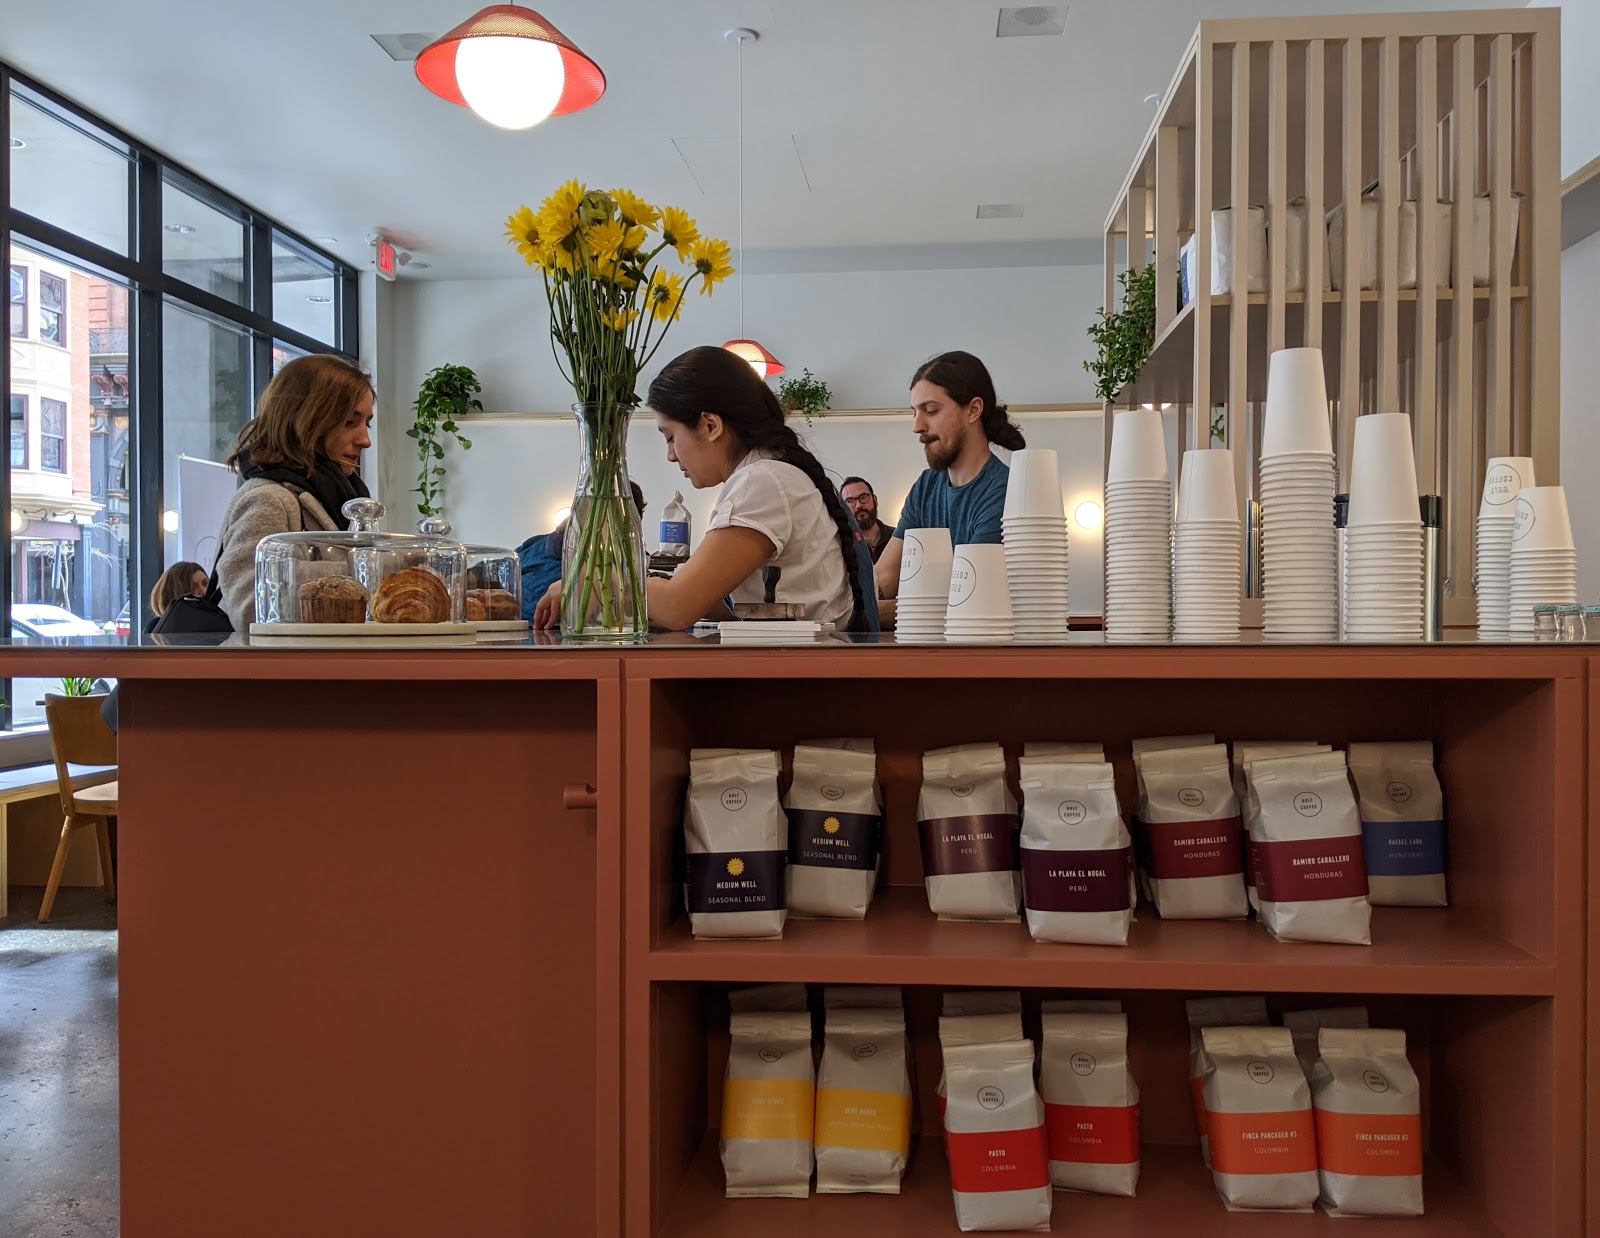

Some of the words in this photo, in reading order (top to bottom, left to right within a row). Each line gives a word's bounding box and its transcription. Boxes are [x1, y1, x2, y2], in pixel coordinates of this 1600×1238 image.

[1488, 475, 1513, 484] COFFEE
[812, 837, 834, 846] MEDIUM
[835, 839, 850, 847] WELL
[1196, 836, 1227, 845] CABALLERO
[802, 851, 835, 859] SEASONAL
[837, 853, 857, 861] BLEND
[1184, 851, 1221, 859] HONDURAS
[1292, 858, 1315, 866] RAMIRO
[1317, 855, 1350, 864] CABALLERO
[1304, 871, 1343, 880] HONDURAS
[716, 881, 739, 889] MEDIUM
[981, 1164, 1017, 1172] COLOMBIA
